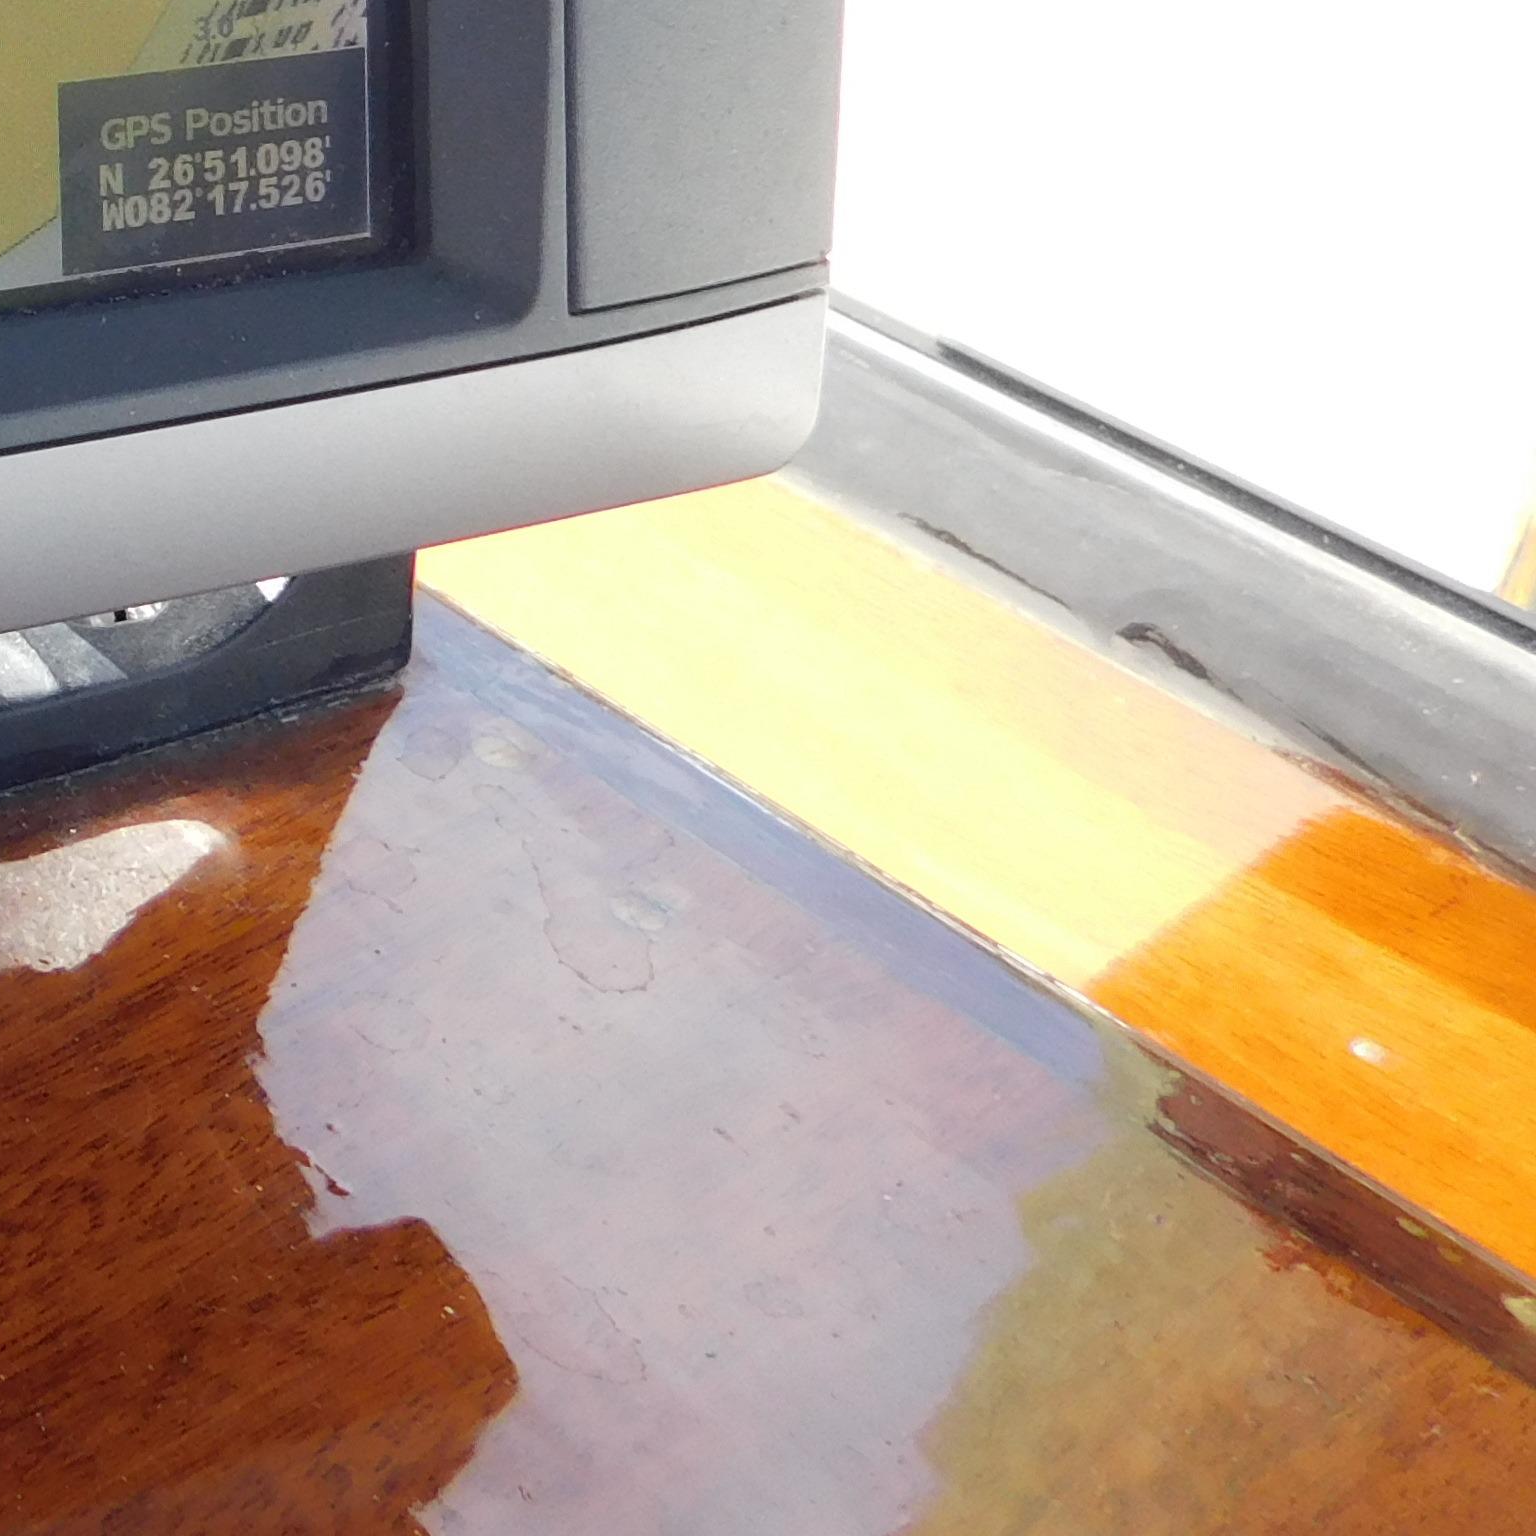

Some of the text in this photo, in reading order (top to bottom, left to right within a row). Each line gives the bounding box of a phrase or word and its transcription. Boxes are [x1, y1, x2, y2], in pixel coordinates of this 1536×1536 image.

[100, 97, 328, 152] GPS Position
[99, 163, 124, 197] N
